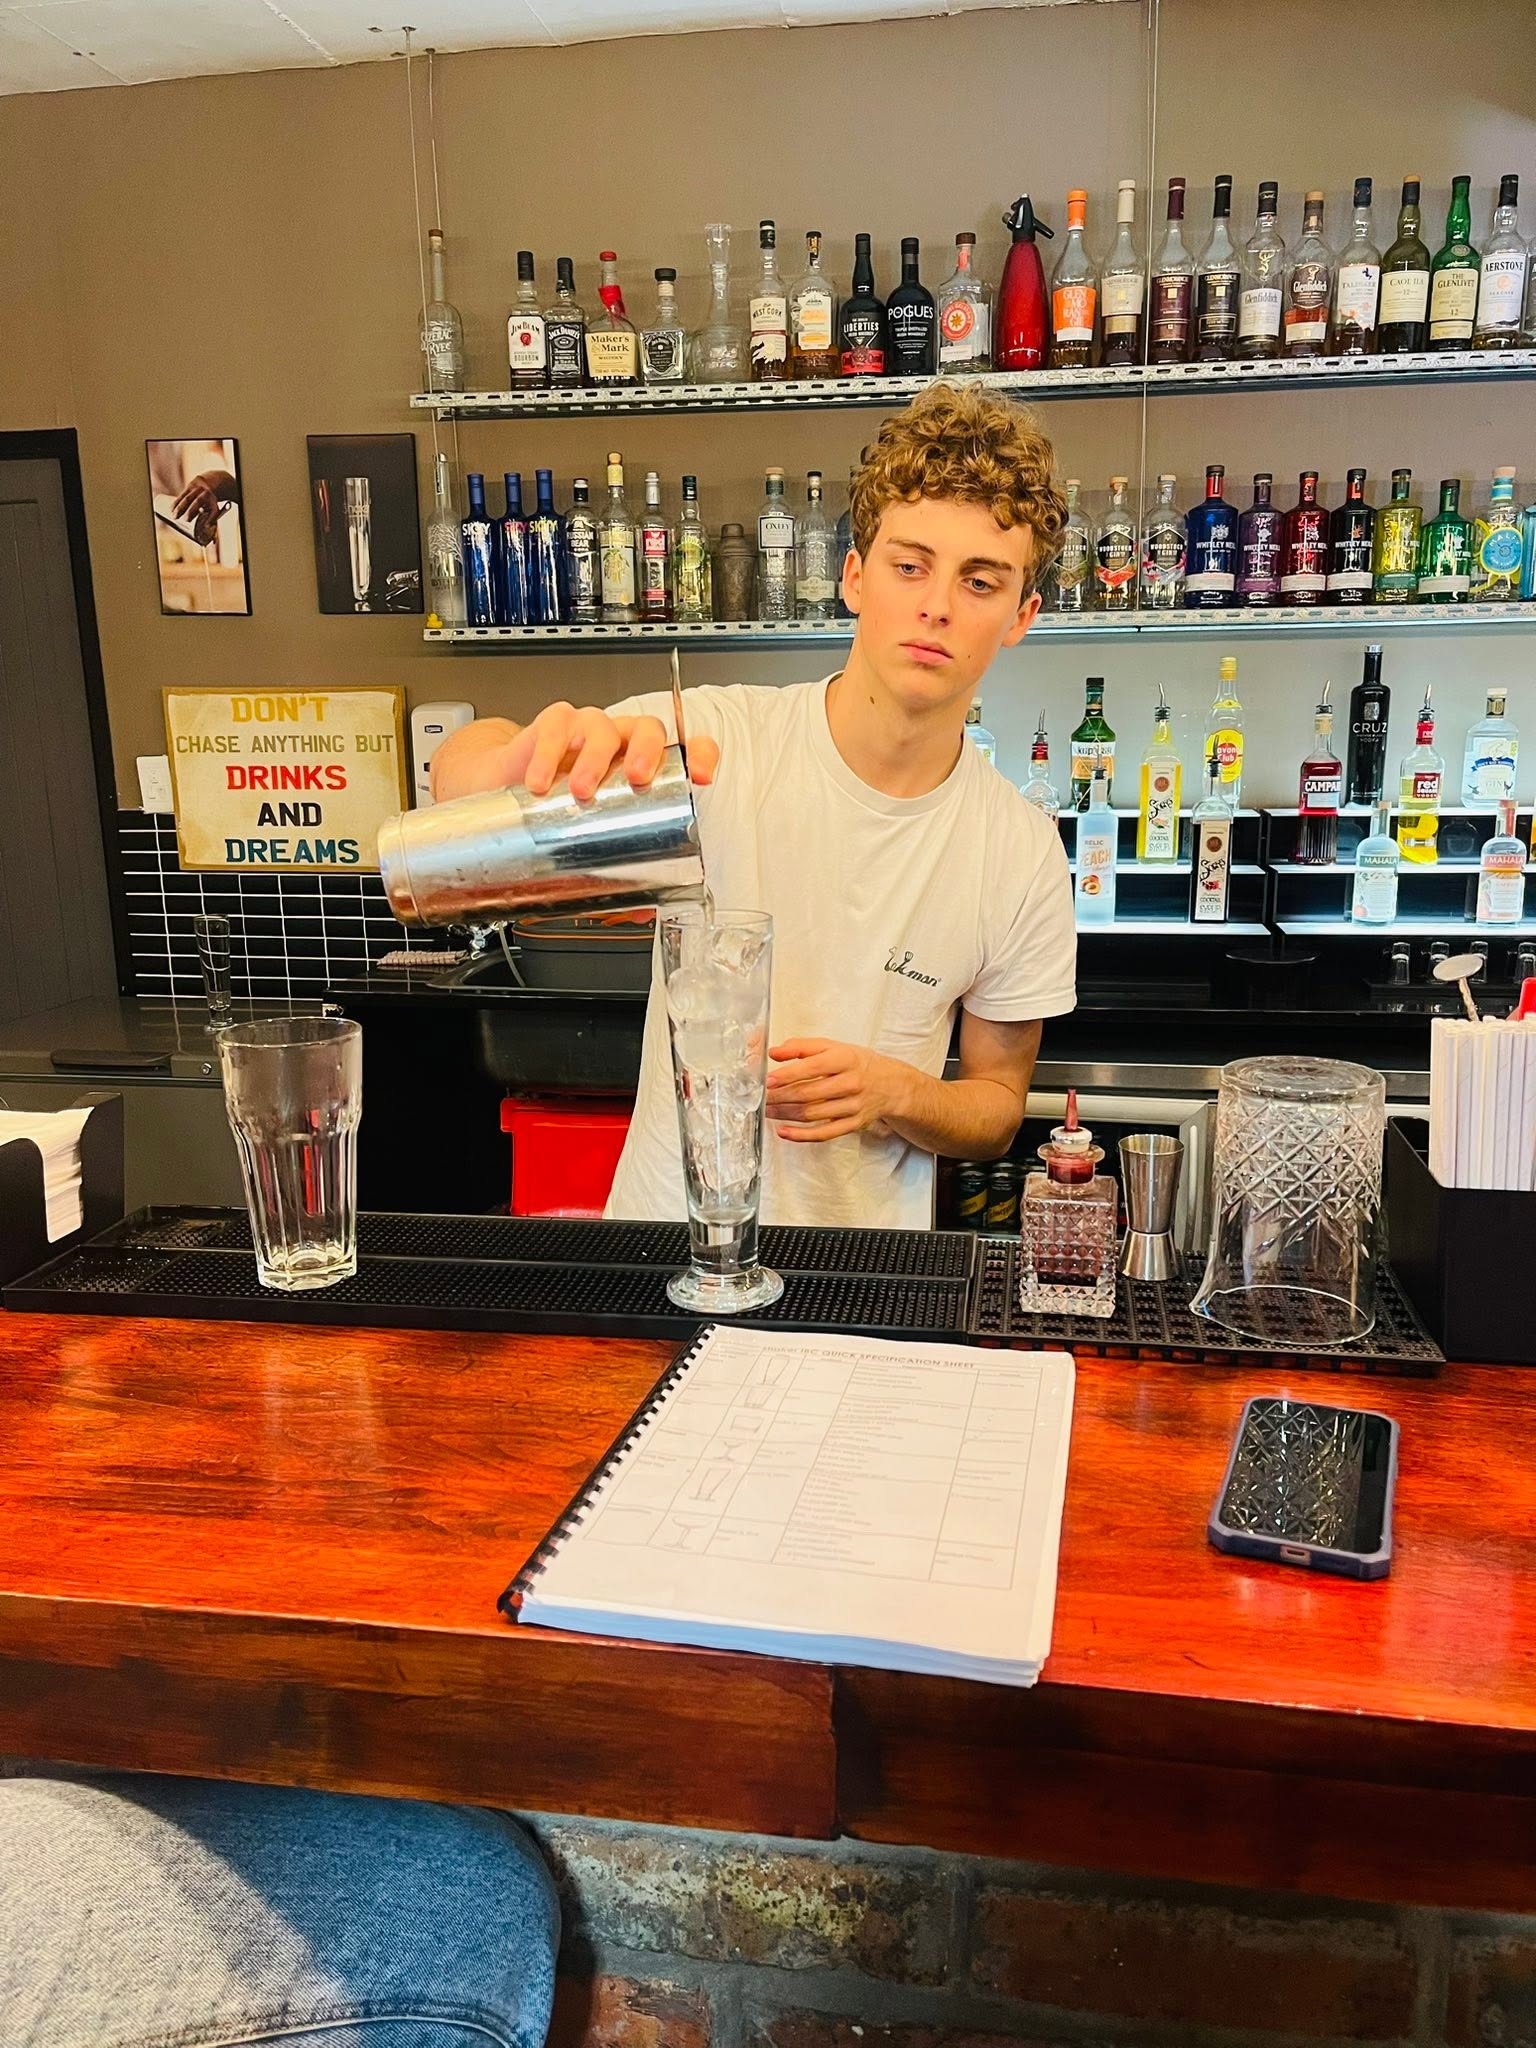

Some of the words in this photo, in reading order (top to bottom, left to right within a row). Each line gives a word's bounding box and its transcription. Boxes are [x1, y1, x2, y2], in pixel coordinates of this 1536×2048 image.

[1485, 261, 1523, 272] AERSTONE
[1293, 281, 1328, 293] Glenfiddich
[1438, 279, 1475, 289] GLENLIVET
[1245, 292, 1278, 304] Glenfiddich
[752, 309, 765, 319] WEST
[888, 304, 934, 320] POGUES
[843, 321, 880, 333] LIBERTIES
[590, 335, 630, 343] Maker's
[601, 343, 630, 352] Mark
[231, 696, 330, 723] DON'T
[1352, 722, 1387, 733] CRUZ
[176, 735, 241, 754] CHASE
[251, 734, 345, 753] ANYTHING
[356, 734, 394, 753] BUT
[1217, 753, 1235, 762] Club
[226, 765, 347, 790] DRINKS
[1417, 776, 1439, 789] red
[257, 802, 323, 827] AND
[224, 838, 361, 864] DREAMS
[822, 1350, 857, 1359] QUICK
[858, 1353, 941, 1367] SPECIFICATION
[943, 1360, 975, 1369] SHEET
